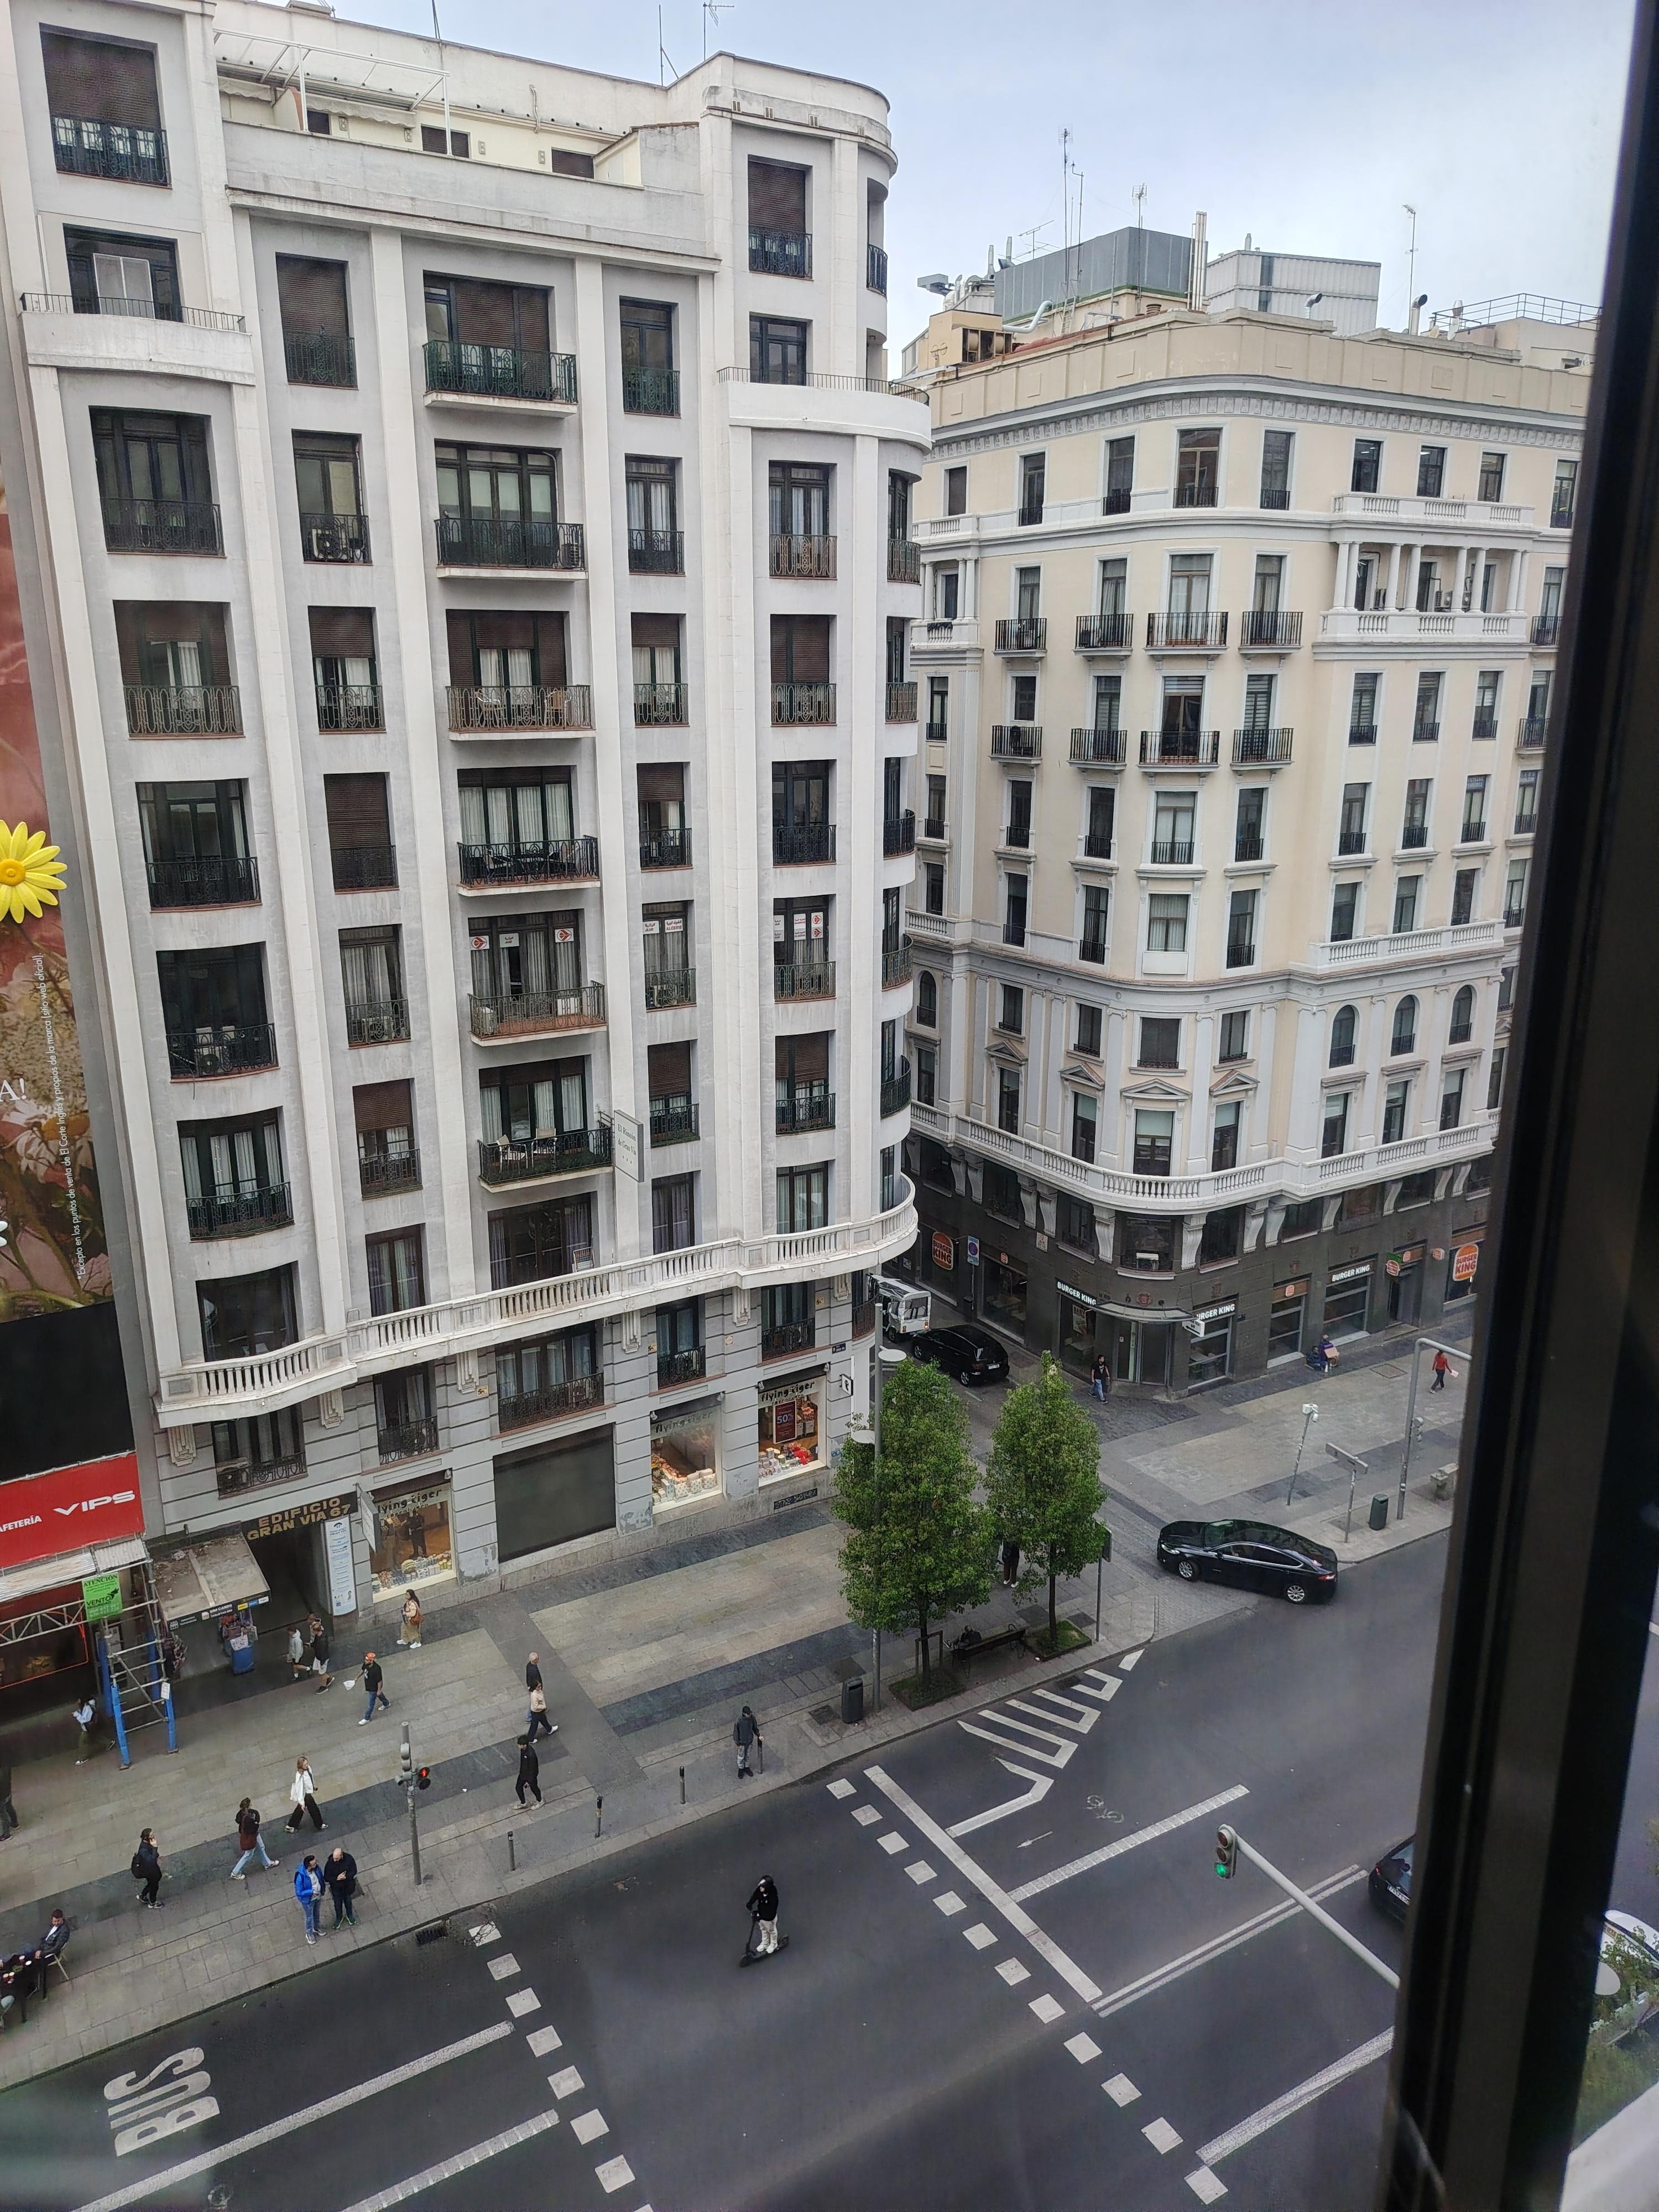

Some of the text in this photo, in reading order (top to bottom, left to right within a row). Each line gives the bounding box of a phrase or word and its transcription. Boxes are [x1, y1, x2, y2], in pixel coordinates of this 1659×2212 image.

[32, 952, 45, 981] oficial).
[39, 982, 48, 999] web
[41, 999, 53, 1019] (sitio
[46, 1020, 54, 1044] marca
[45, 1046, 56, 1055] la
[46, 1054, 58, 1065] de
[50, 1067, 62, 1095] propios
[54, 1103, 66, 1125] Inglés
[59, 1125, 69, 1147] Corte
[618, 1124, 636, 1141] El Rincón
[618, 1138, 622, 1146] de
[61, 1156, 71, 1167] de
[64, 1167, 74, 1187] venta
[66, 1188, 76, 1199] de
[70, 1199, 82, 1224] puntos
[71, 1224, 81, 1237] los
[76, 1237, 82, 1245] en
[933, 1240, 952, 1255] BURGER
[933, 1246, 952, 1265] KING
[1456, 1254, 1477, 1265] BURGER
[1332, 1264, 1370, 1282] BURGER KING
[1455, 1261, 1476, 1274] KING
[1057, 1281, 1097, 1306] BURGER KING
[1196, 1303, 1235, 1321] URGER KING
[761, 1389, 789, 1402] flying
[791, 1381, 815, 1393] tiger
[654, 1420, 685, 1433] flying
[53, 1490, 135, 1516] VIPS
[377, 1489, 442, 1514] lying tiger
[258, 1497, 341, 1527] EDIFICIO
[247, 1519, 295, 1540] GRAN
[300, 1511, 327, 1525] VIA
[330, 1504, 351, 1517] 67
[86, 1595, 111, 1606] VENTO
[103, 2047, 221, 2157] BUS
